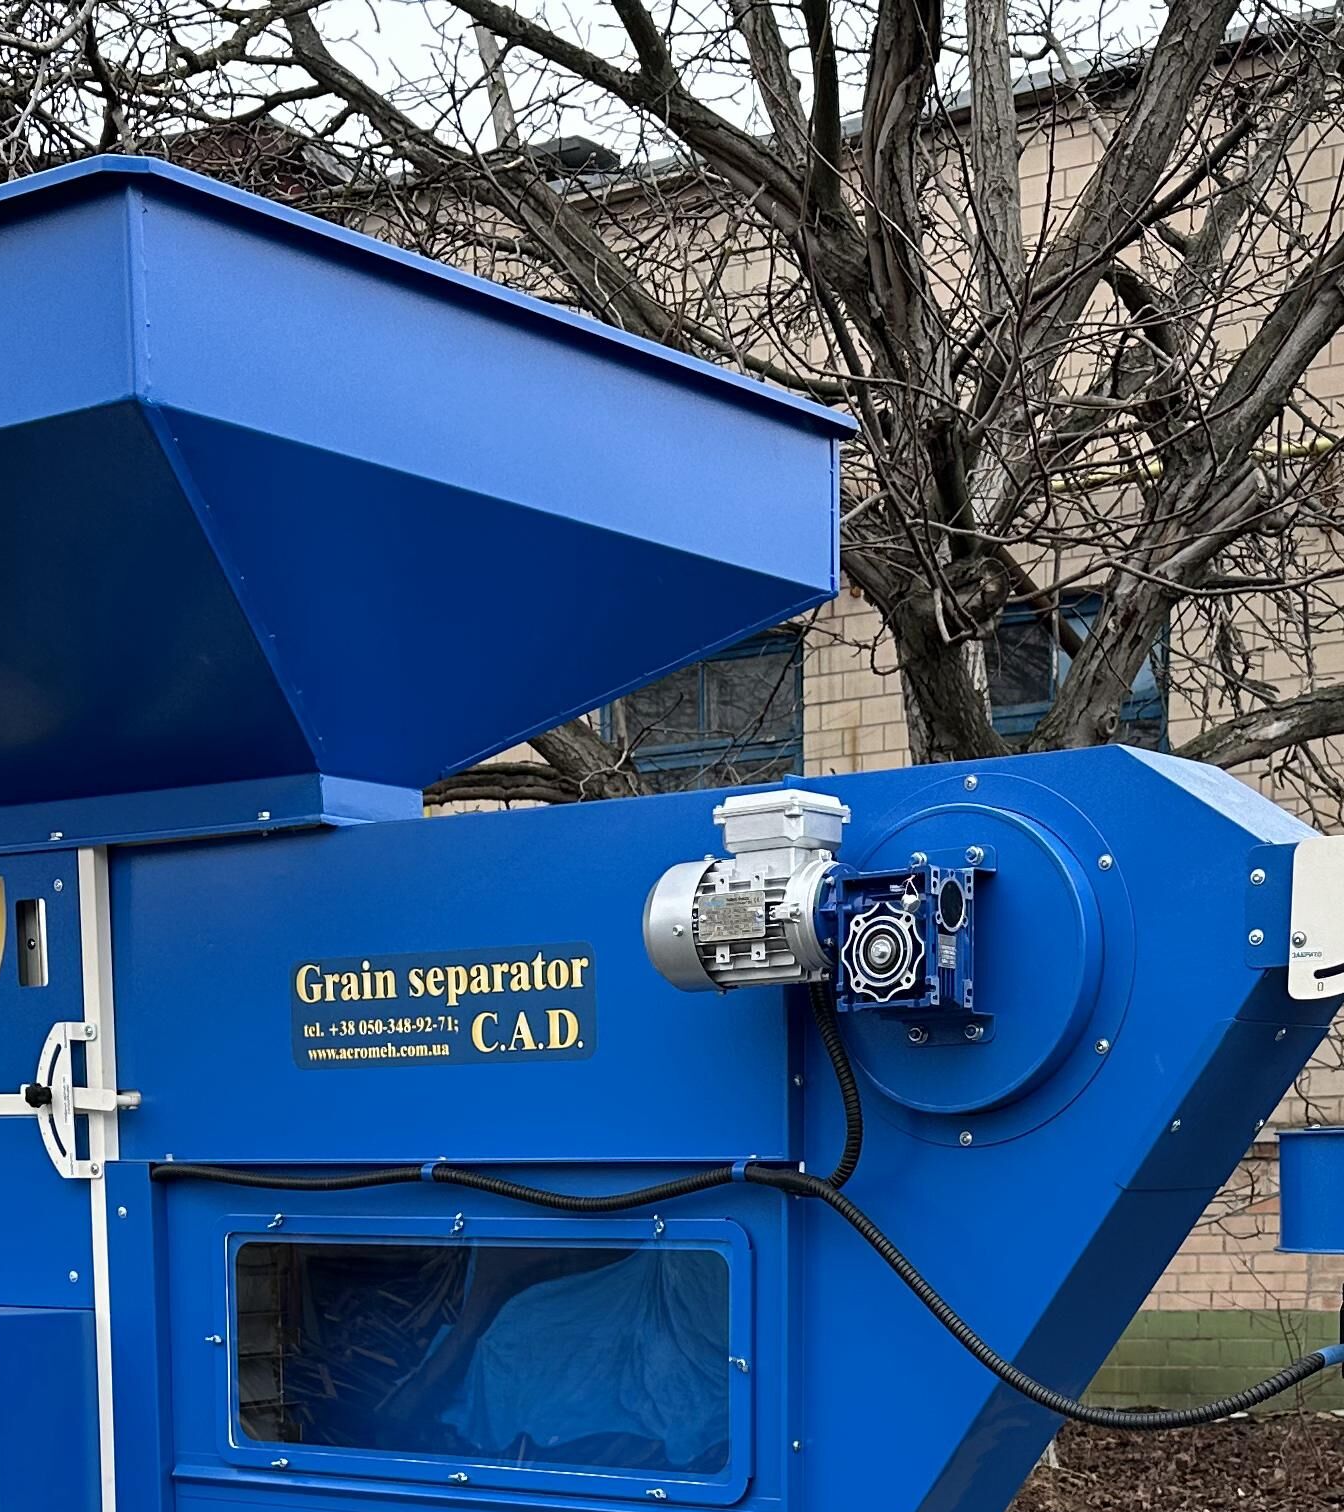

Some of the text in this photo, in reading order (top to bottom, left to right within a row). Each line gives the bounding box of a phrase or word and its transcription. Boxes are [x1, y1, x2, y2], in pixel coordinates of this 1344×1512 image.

[295, 951, 589, 1007] Grain separator
[1317, 981, 1324, 992] 0
[328, 1020, 356, 1037] +38
[358, 1015, 460, 1036] 050-348-92-71;
[470, 1008, 585, 1054] C.A.D.
[307, 1042, 451, 1062] www.aeromeh.com.ua
